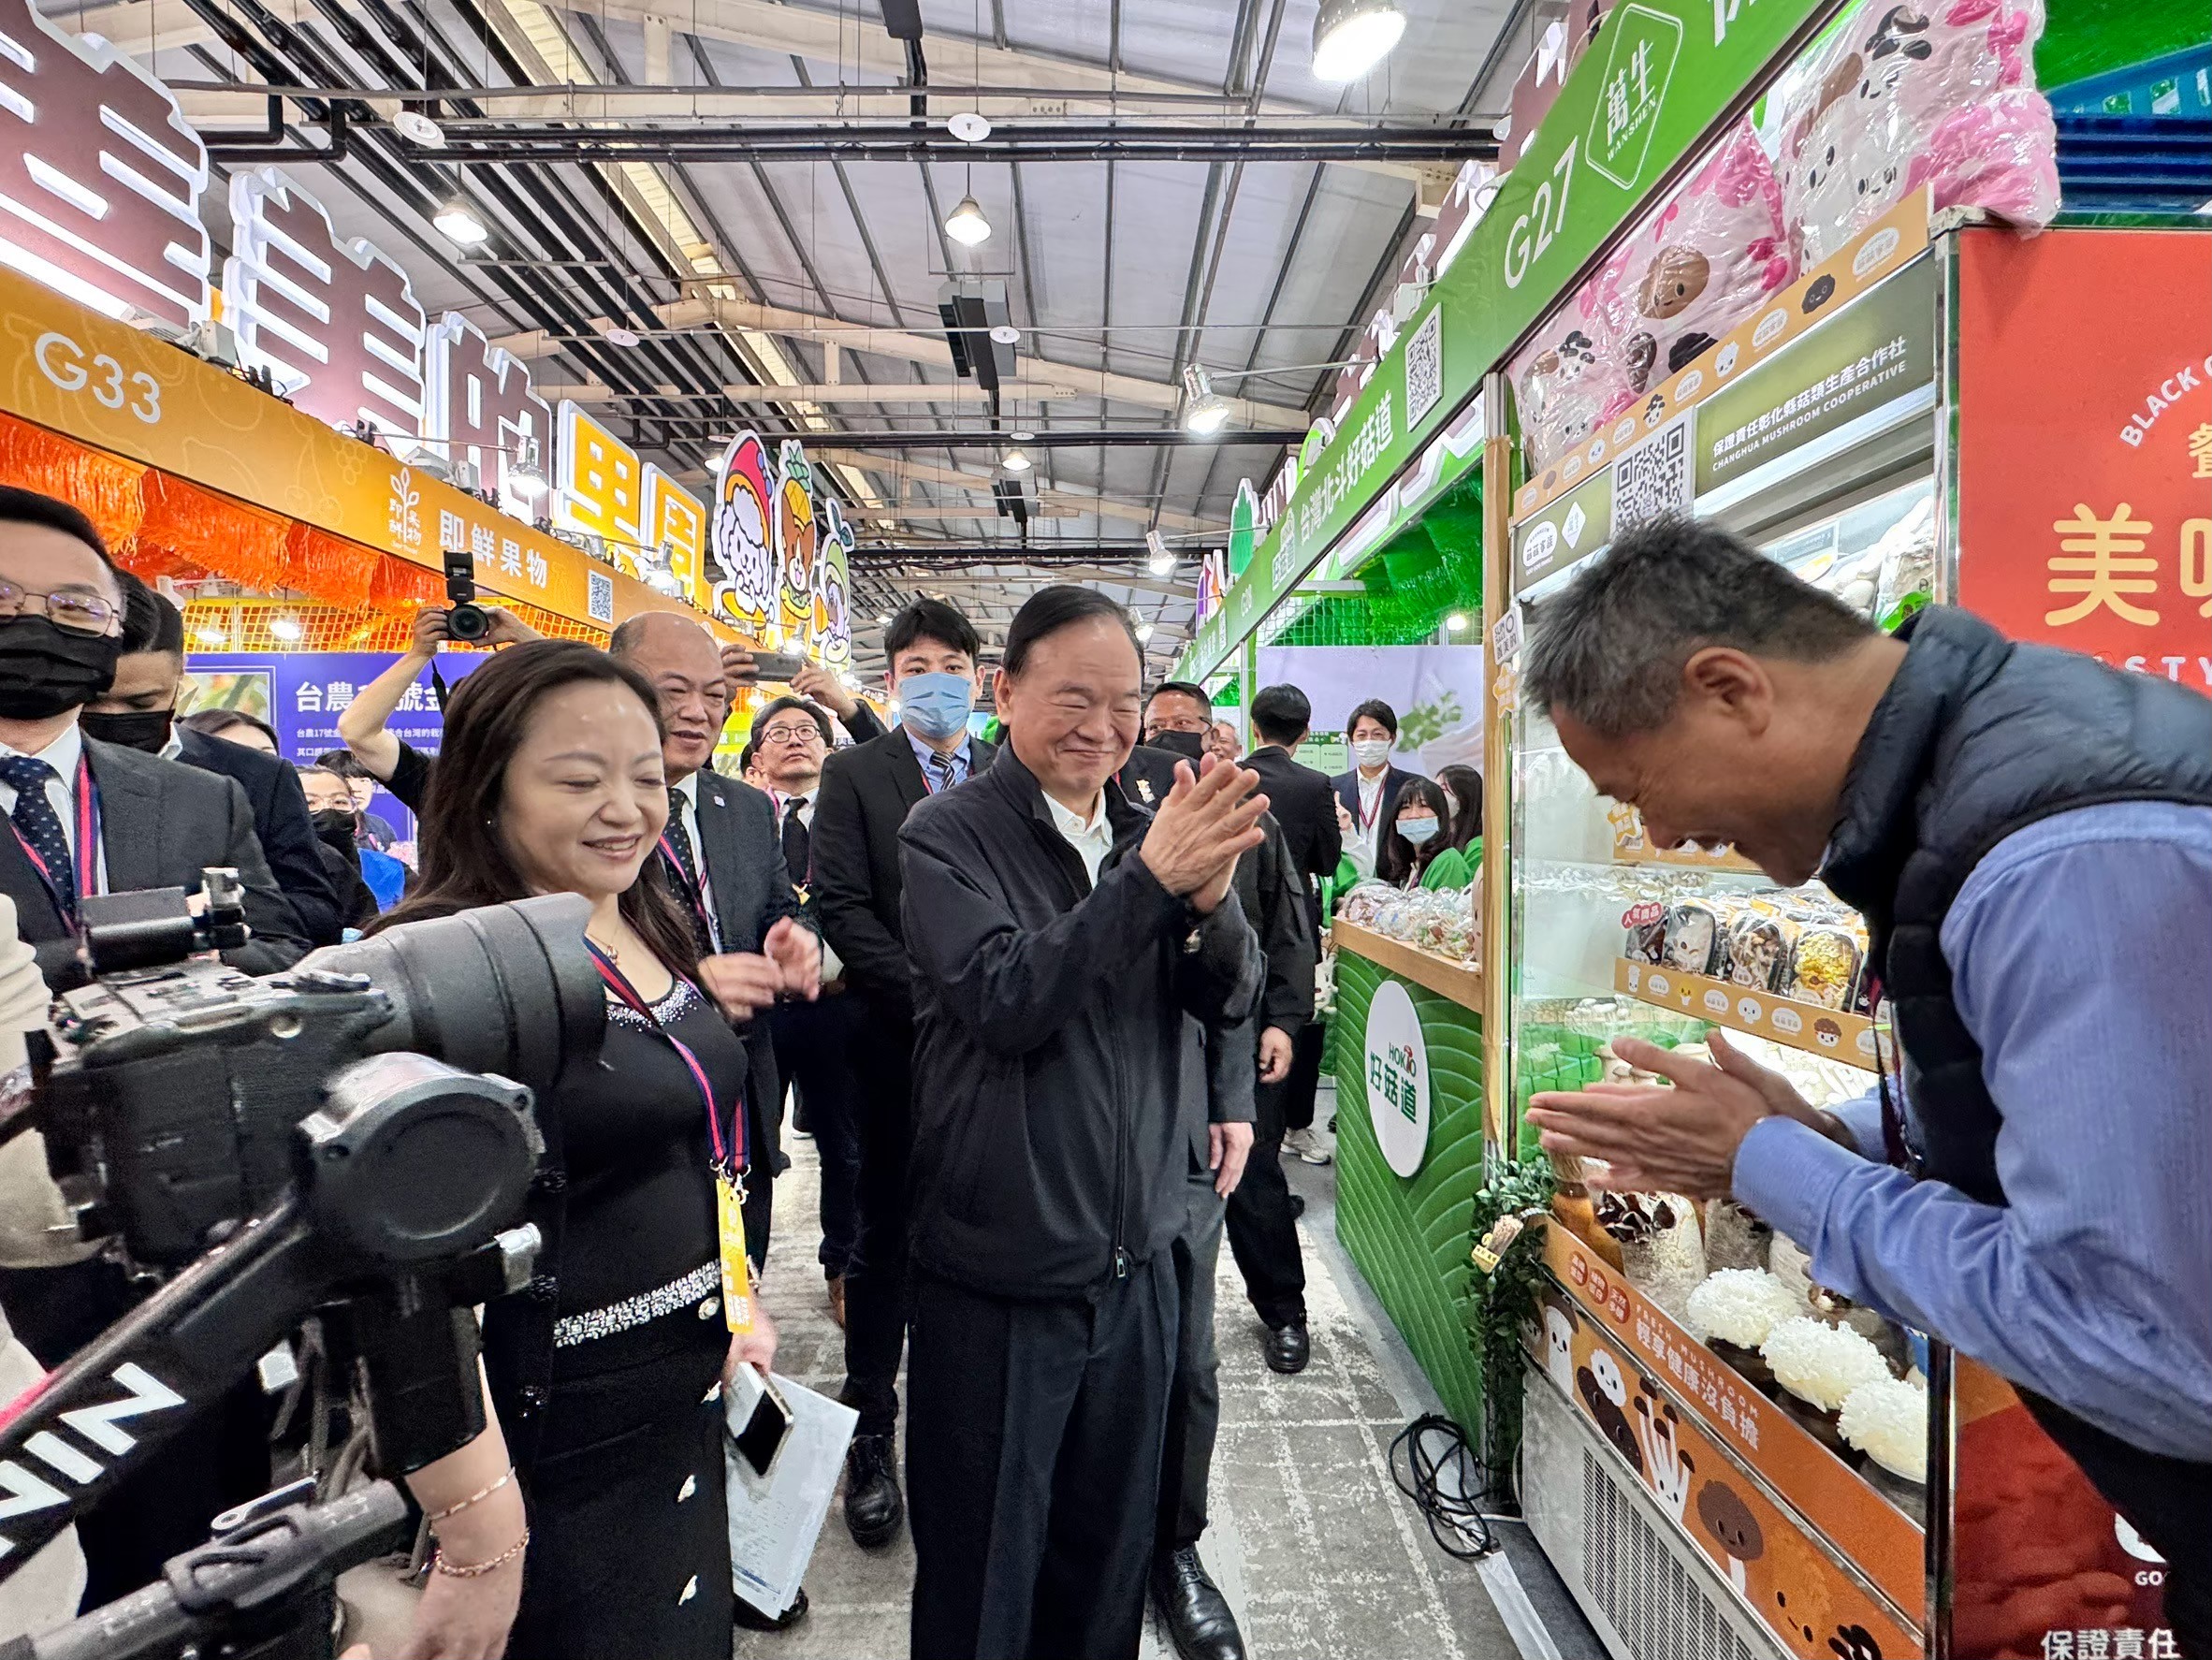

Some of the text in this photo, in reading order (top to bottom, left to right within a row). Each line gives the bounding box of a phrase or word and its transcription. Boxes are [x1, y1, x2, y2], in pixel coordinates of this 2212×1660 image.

[1606, 39, 1655, 146] 萬生
[1607, 95, 1656, 162] WANSHEN
[1504, 135, 1578, 289] G27
[35, 331, 161, 424] G33
[1713, 335, 1907, 458] 保證責任彰化縣菇類生產合作社
[1713, 359, 1906, 472] CHANGHUA MUSHROOM COOPERATIVE
[2119, 366, 2201, 447] BLACK
[439, 508, 547, 589] 即鮮果物
[1370, 1050, 1417, 1125] 好菇道
[1637, 1304, 1759, 1418] FRESH MUSHROOM
[1637, 1318, 1759, 1450] 輕享健康沒負擔
[2041, 1627, 2183, 1660] 保證責任
